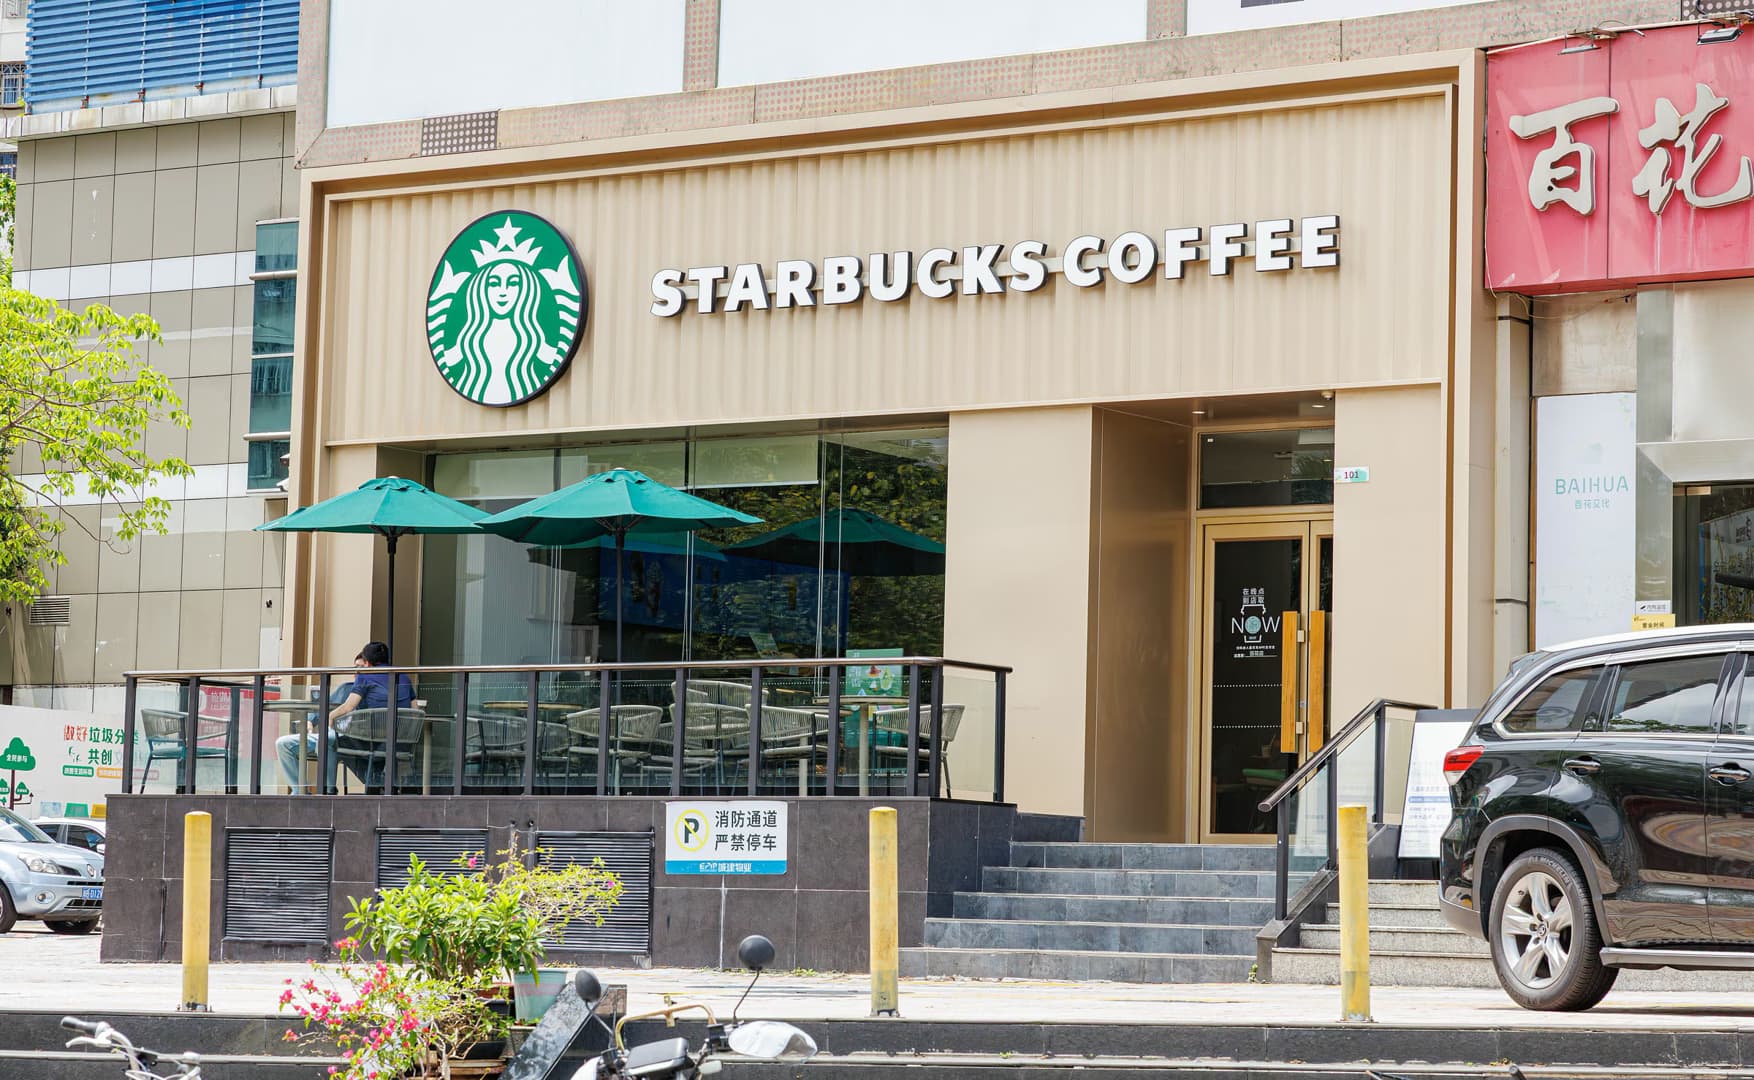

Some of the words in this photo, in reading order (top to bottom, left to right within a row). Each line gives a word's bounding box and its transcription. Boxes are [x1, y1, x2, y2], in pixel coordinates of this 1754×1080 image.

[1509, 83, 1754, 216] 百花
[650, 239, 1048, 317] STARBUCKS
[1062, 215, 1339, 288] COFFEE
[1344, 471, 1359, 479] 101
[1554, 475, 1629, 495] BAIHUA
[715, 810, 777, 828] 消防通道
[714, 834, 777, 851] 严禁停车
